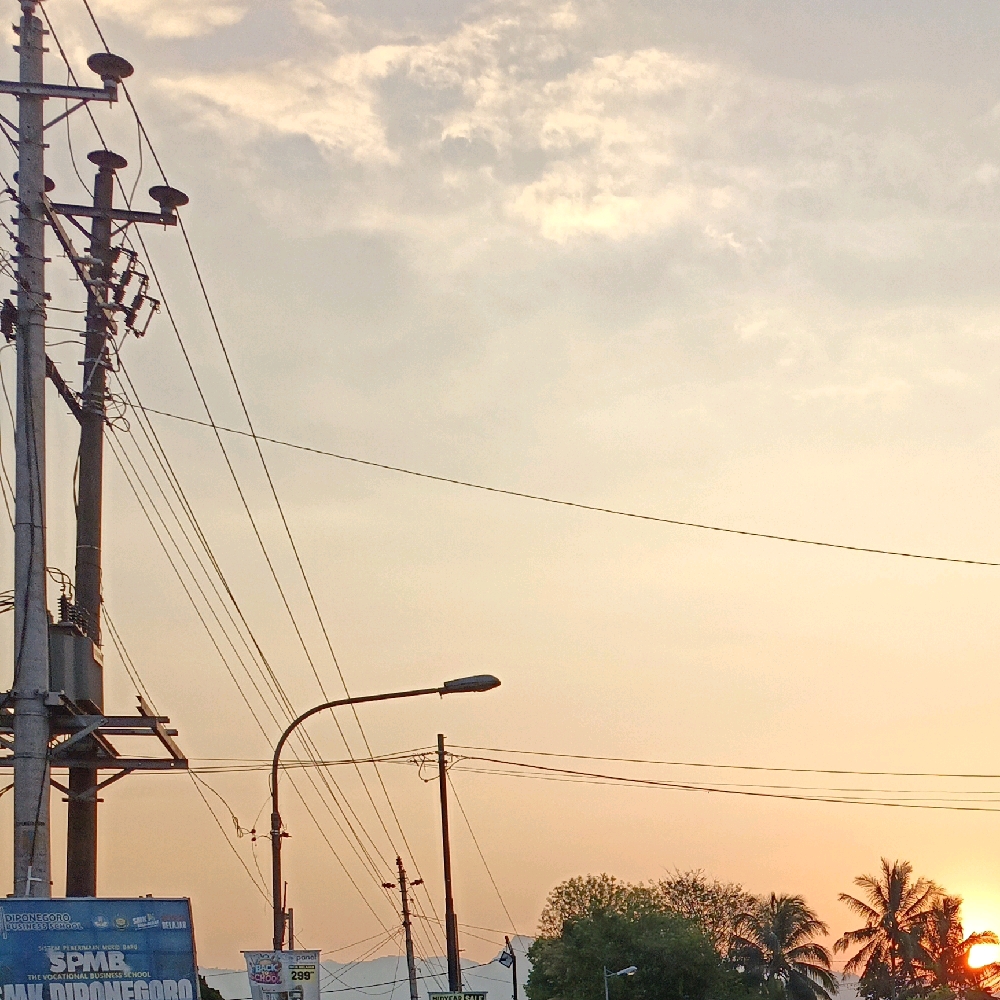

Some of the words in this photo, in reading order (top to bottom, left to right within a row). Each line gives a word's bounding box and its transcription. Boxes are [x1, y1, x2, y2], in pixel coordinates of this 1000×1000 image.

[5, 913, 70, 923] DIPONEGORO
[6, 922, 48, 931] BUSINESS
[49, 921, 83, 931] SCHOOL
[50, 951, 127, 973] SPMB
[255, 963, 279, 973] BACK
[42, 973, 88, 981] VOCATIONAL
[291, 970, 312, 981] 299
